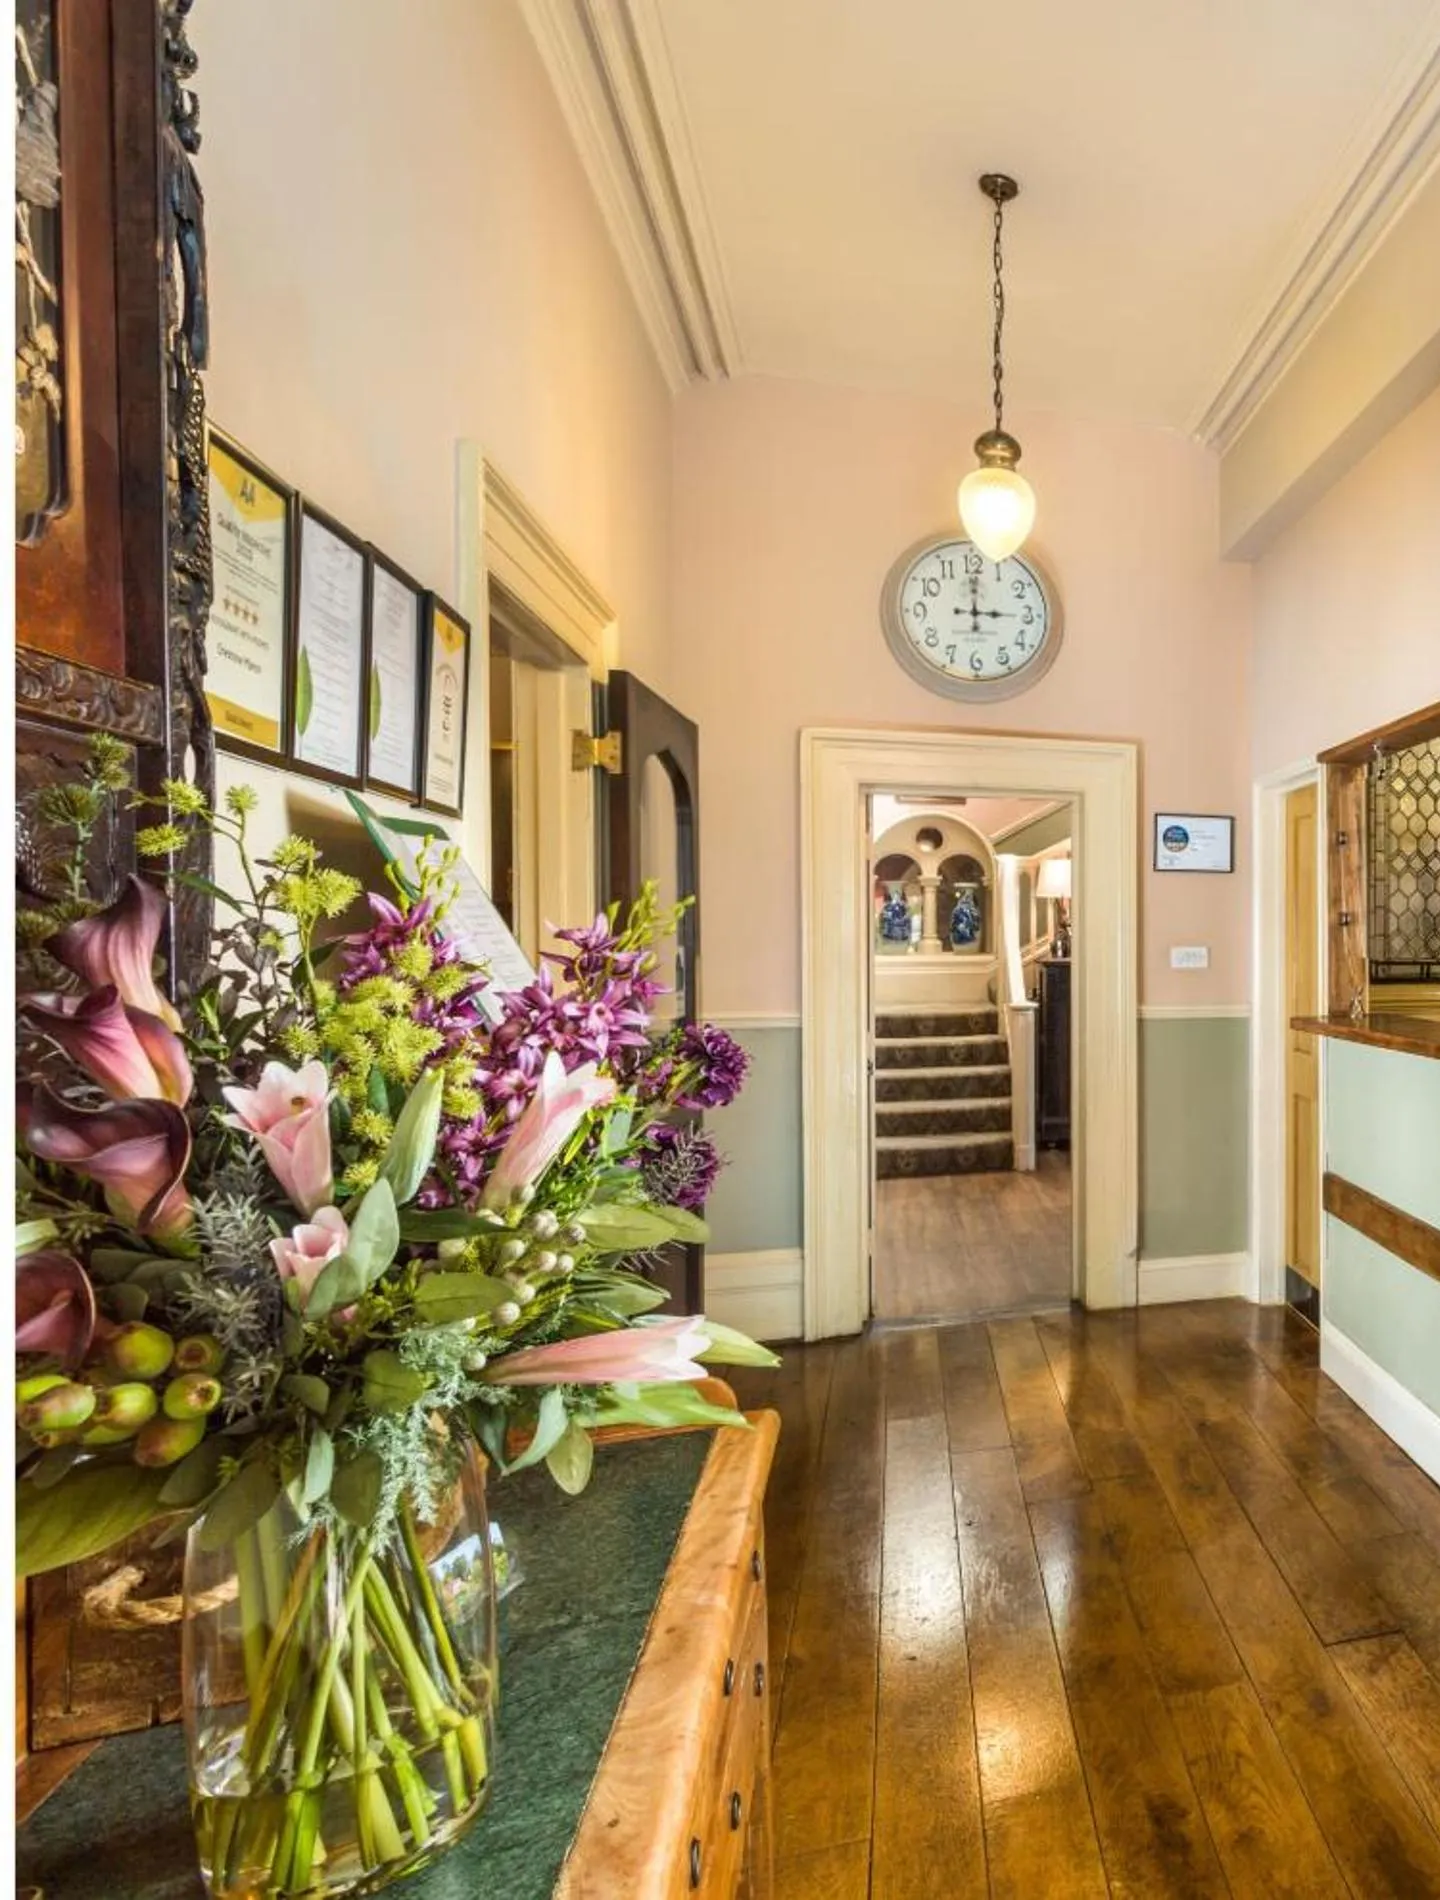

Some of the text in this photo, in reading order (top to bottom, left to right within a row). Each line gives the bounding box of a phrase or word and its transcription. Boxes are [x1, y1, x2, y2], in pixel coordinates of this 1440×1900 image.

[940, 559, 955, 579] 11
[963, 553, 984, 574] 12
[995, 561, 1002, 582] 1
[921, 577, 941, 597] 10
[1011, 579, 1026, 599] 2
[912, 601, 927, 623] 9
[1022, 604, 1035, 625] 3
[924, 626, 939, 648] 8
[1014, 628, 1026, 651] 4
[945, 643, 957, 664] 7
[969, 650, 983, 671] 6
[995, 646, 1010, 665] 5
